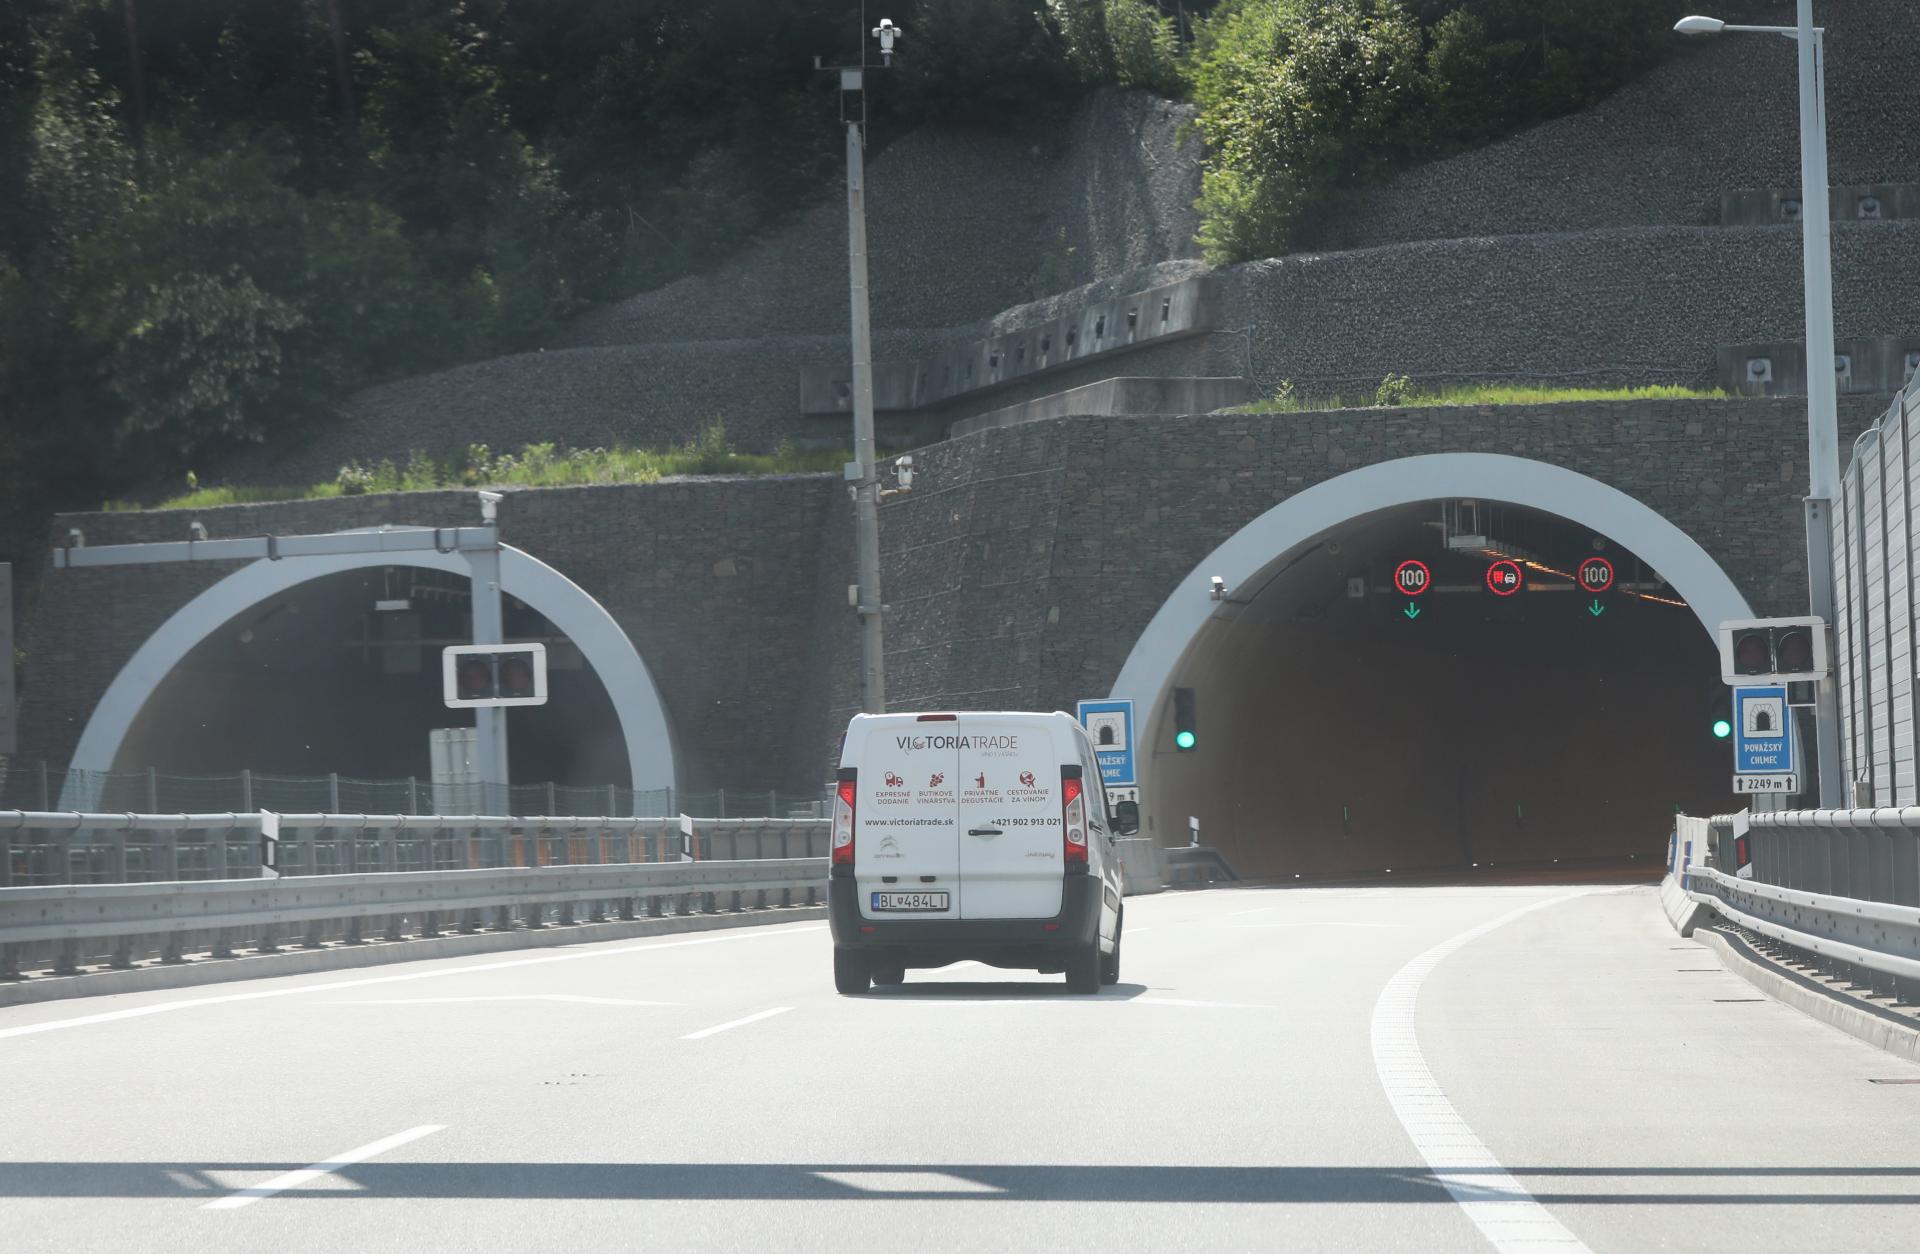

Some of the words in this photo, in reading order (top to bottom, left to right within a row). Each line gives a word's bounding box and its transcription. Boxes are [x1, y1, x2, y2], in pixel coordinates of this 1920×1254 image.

[1400, 569, 1425, 586] 100
[1583, 567, 1608, 583] 100
[1744, 742, 1783, 753] POVAŽSKÝ
[1099, 755, 1126, 765] VAŽSKÝ
[1750, 756, 1777, 764] CHLMEC
[1102, 768, 1120, 777] LMEC
[1748, 779, 1771, 789] 2249
[1007, 788, 1049, 796] CESTOVANIE
[865, 818, 954, 826] www.victoriatrade.sk
[991, 818, 1010, 826] +421
[1012, 818, 1029, 826] 902
[1030, 818, 1045, 826] 913
[1046, 818, 1061, 826] 021
